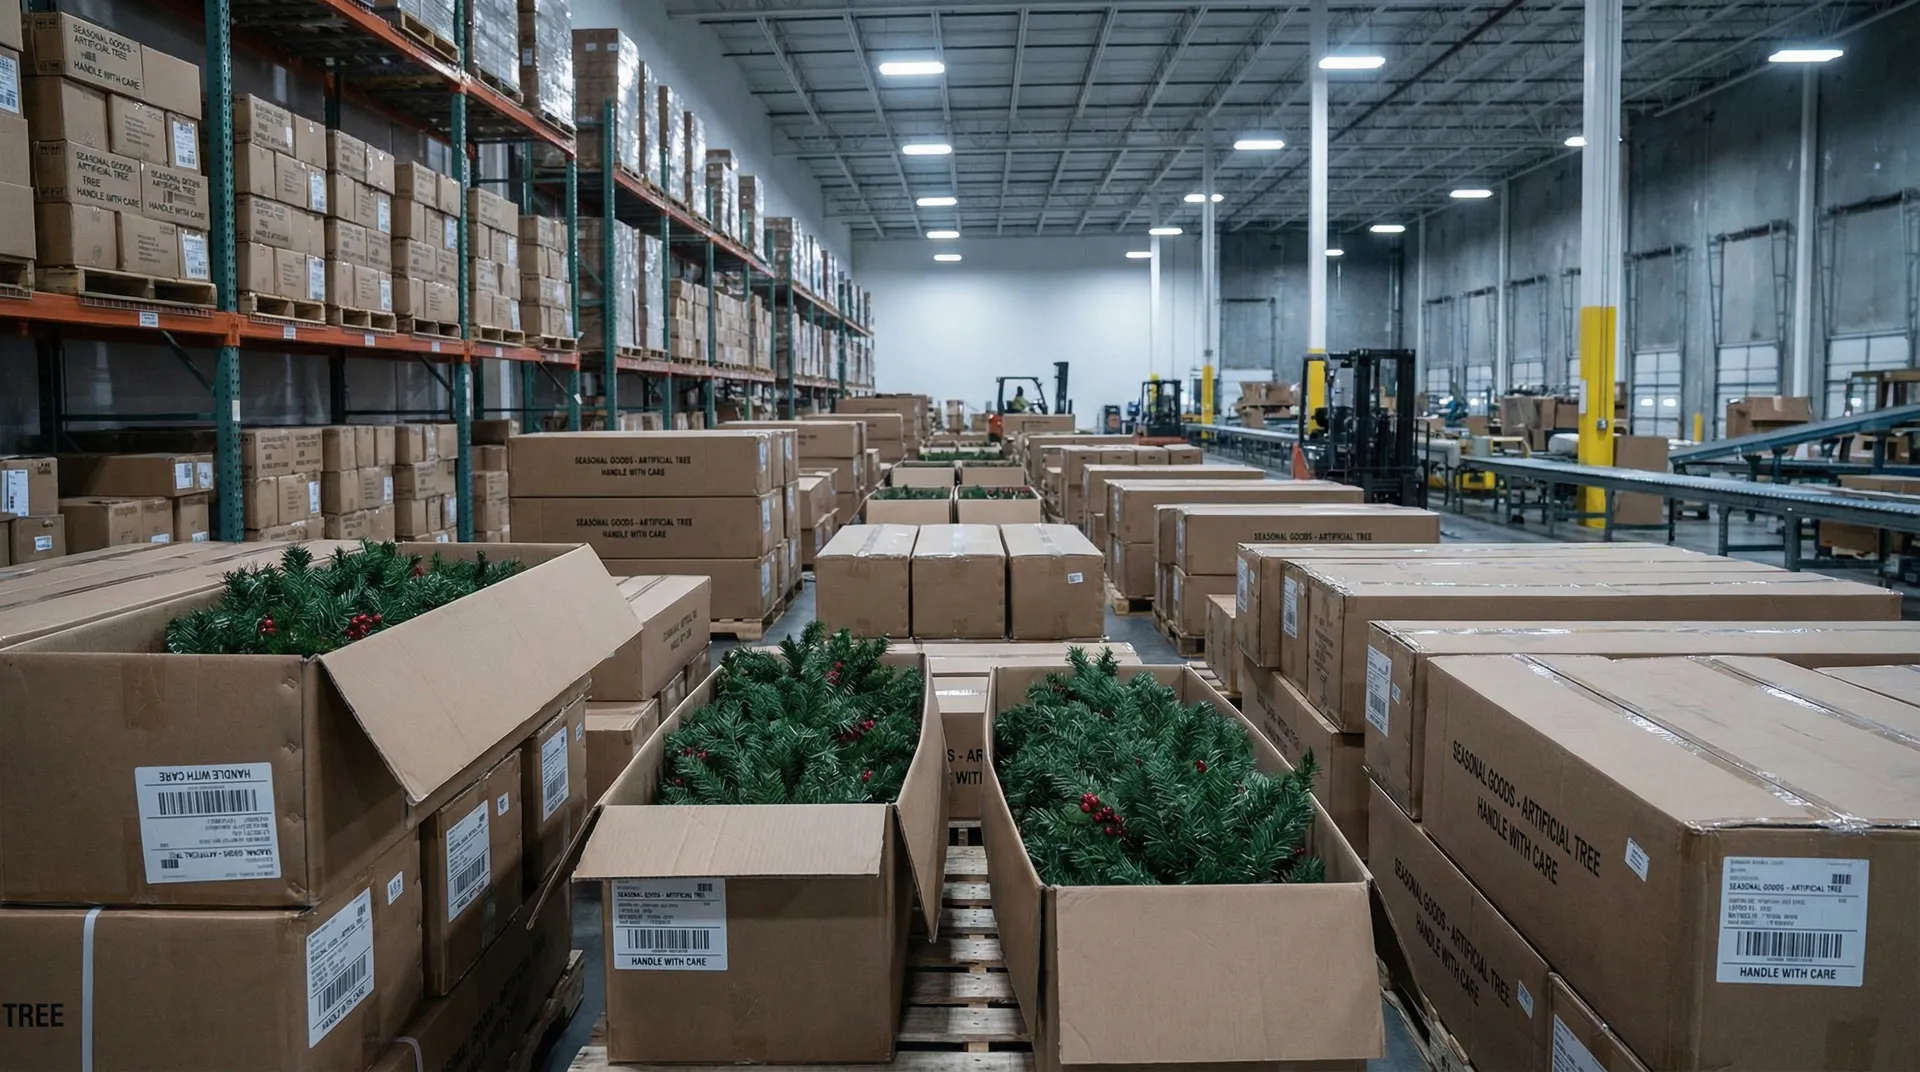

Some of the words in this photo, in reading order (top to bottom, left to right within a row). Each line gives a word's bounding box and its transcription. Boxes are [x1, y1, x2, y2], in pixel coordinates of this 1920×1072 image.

[574, 456, 609, 465] SEASONAL
[610, 456, 633, 465] GOODS
[638, 456, 674, 465] ARTIFICIAL
[675, 456, 692, 465] TREE
[601, 468, 628, 476] HANDLE
[629, 468, 646, 476] WITH
[647, 468, 665, 476] CARE
[576, 518, 609, 527] SEASONAL
[610, 518, 634, 527] GOODS
[639, 518, 675, 527] ARTIFICIAL
[676, 518, 693, 527] TREE
[602, 529, 629, 538] HANDLE
[630, 529, 648, 538] WITH
[648, 529, 667, 538] CARE
[1254, 532, 1288, 541] SEASONAL
[1289, 532, 1312, 541] GOODS
[1319, 532, 1354, 541] ARTIFICIAL
[1355, 532, 1373, 541] TREE
[159, 771, 185, 782] CARE
[187, 770, 212, 780] WITH
[213, 769, 251, 779] HANDLE
[1453, 740, 1487, 787] SEASONAL
[1488, 768, 1516, 808] GOODS
[1521, 795, 1572, 856] ARTIFICIAL
[1574, 834, 1601, 878] TREE
[1477, 795, 1508, 841] HANDLE
[1509, 822, 1531, 861] WITH
[1532, 845, 1559, 886] CARE
[1729, 883, 1762, 891] SEASONAL
[1394, 857, 1423, 906] SEASONAL
[1424, 892, 1446, 932] GOODS
[1450, 924, 1489, 984] ARTIFICIAL
[1490, 967, 1511, 1009] TREE
[631, 957, 663, 967] HANDLE
[664, 957, 685, 966] WITH
[686, 957, 707, 967] CARE
[1415, 911, 1441, 958] HANDLE
[1441, 942, 1460, 982] WITH
[1460, 968, 1480, 1007] CARE
[1740, 966, 1779, 979] HANDLE
[1781, 968, 1808, 979] WITH
[1810, 969, 1837, 980] CARE
[2, 1003, 64, 1028] TREE
